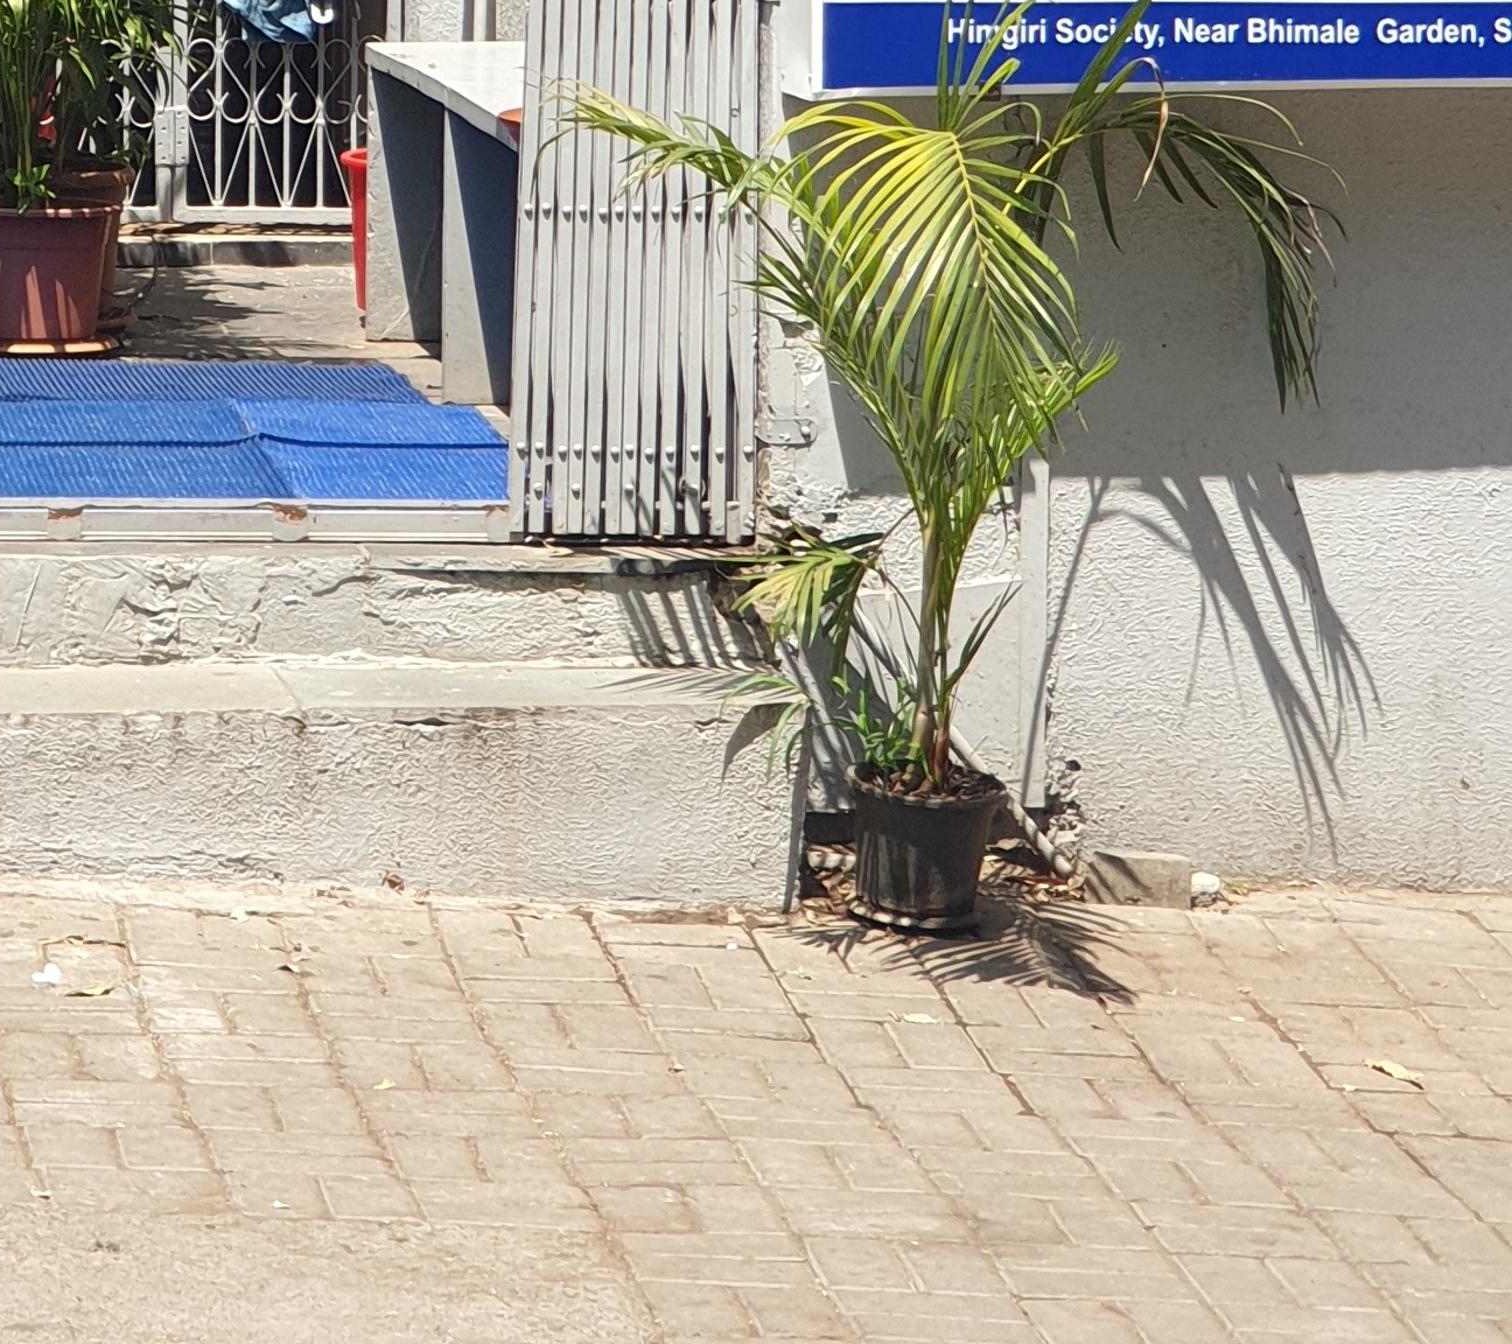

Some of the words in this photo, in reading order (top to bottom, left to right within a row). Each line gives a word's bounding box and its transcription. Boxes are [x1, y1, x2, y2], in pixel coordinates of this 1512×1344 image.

[1055, 18, 1164, 49] Socity,
[1174, 20, 1238, 44] Near
[1247, 18, 1360, 45] Bhimale
[1377, 18, 1486, 49] Garden,
